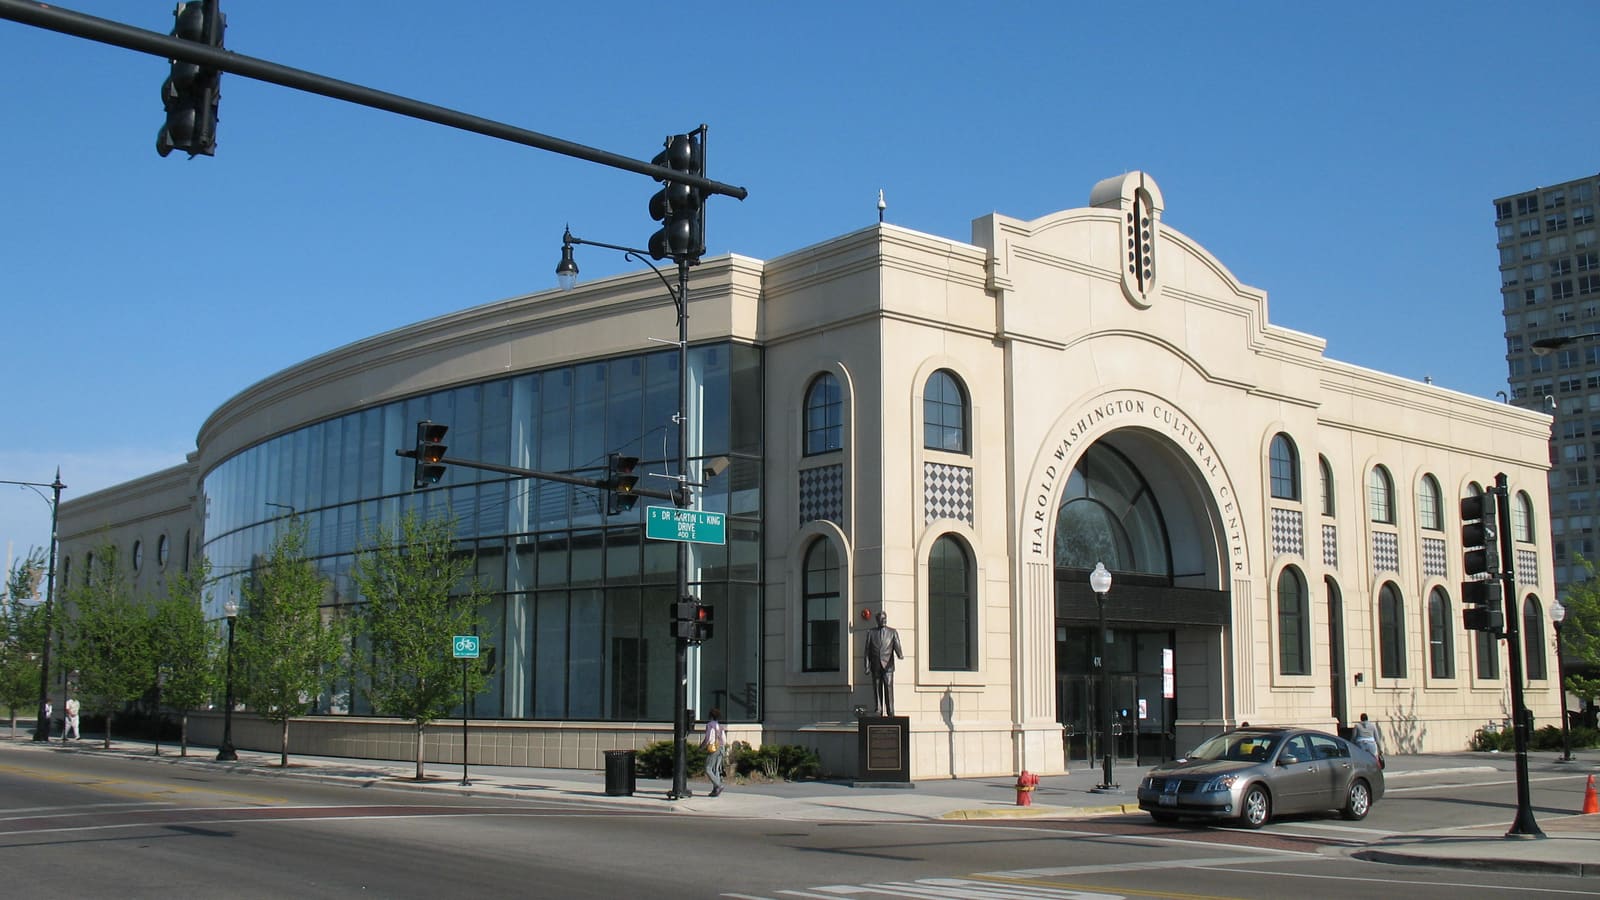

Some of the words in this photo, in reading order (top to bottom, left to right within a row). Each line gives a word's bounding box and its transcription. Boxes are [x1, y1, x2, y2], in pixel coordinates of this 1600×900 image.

[1032, 465, 1056, 555] HAROLD
[1055, 400, 1145, 461] WASHINGTON
[1153, 406, 1217, 477] CULTURAL
[1219, 486, 1243, 572] CENTER
[661, 511, 671, 520] DR
[706, 516, 721, 526] KING
[677, 523, 696, 532] DRIVE
